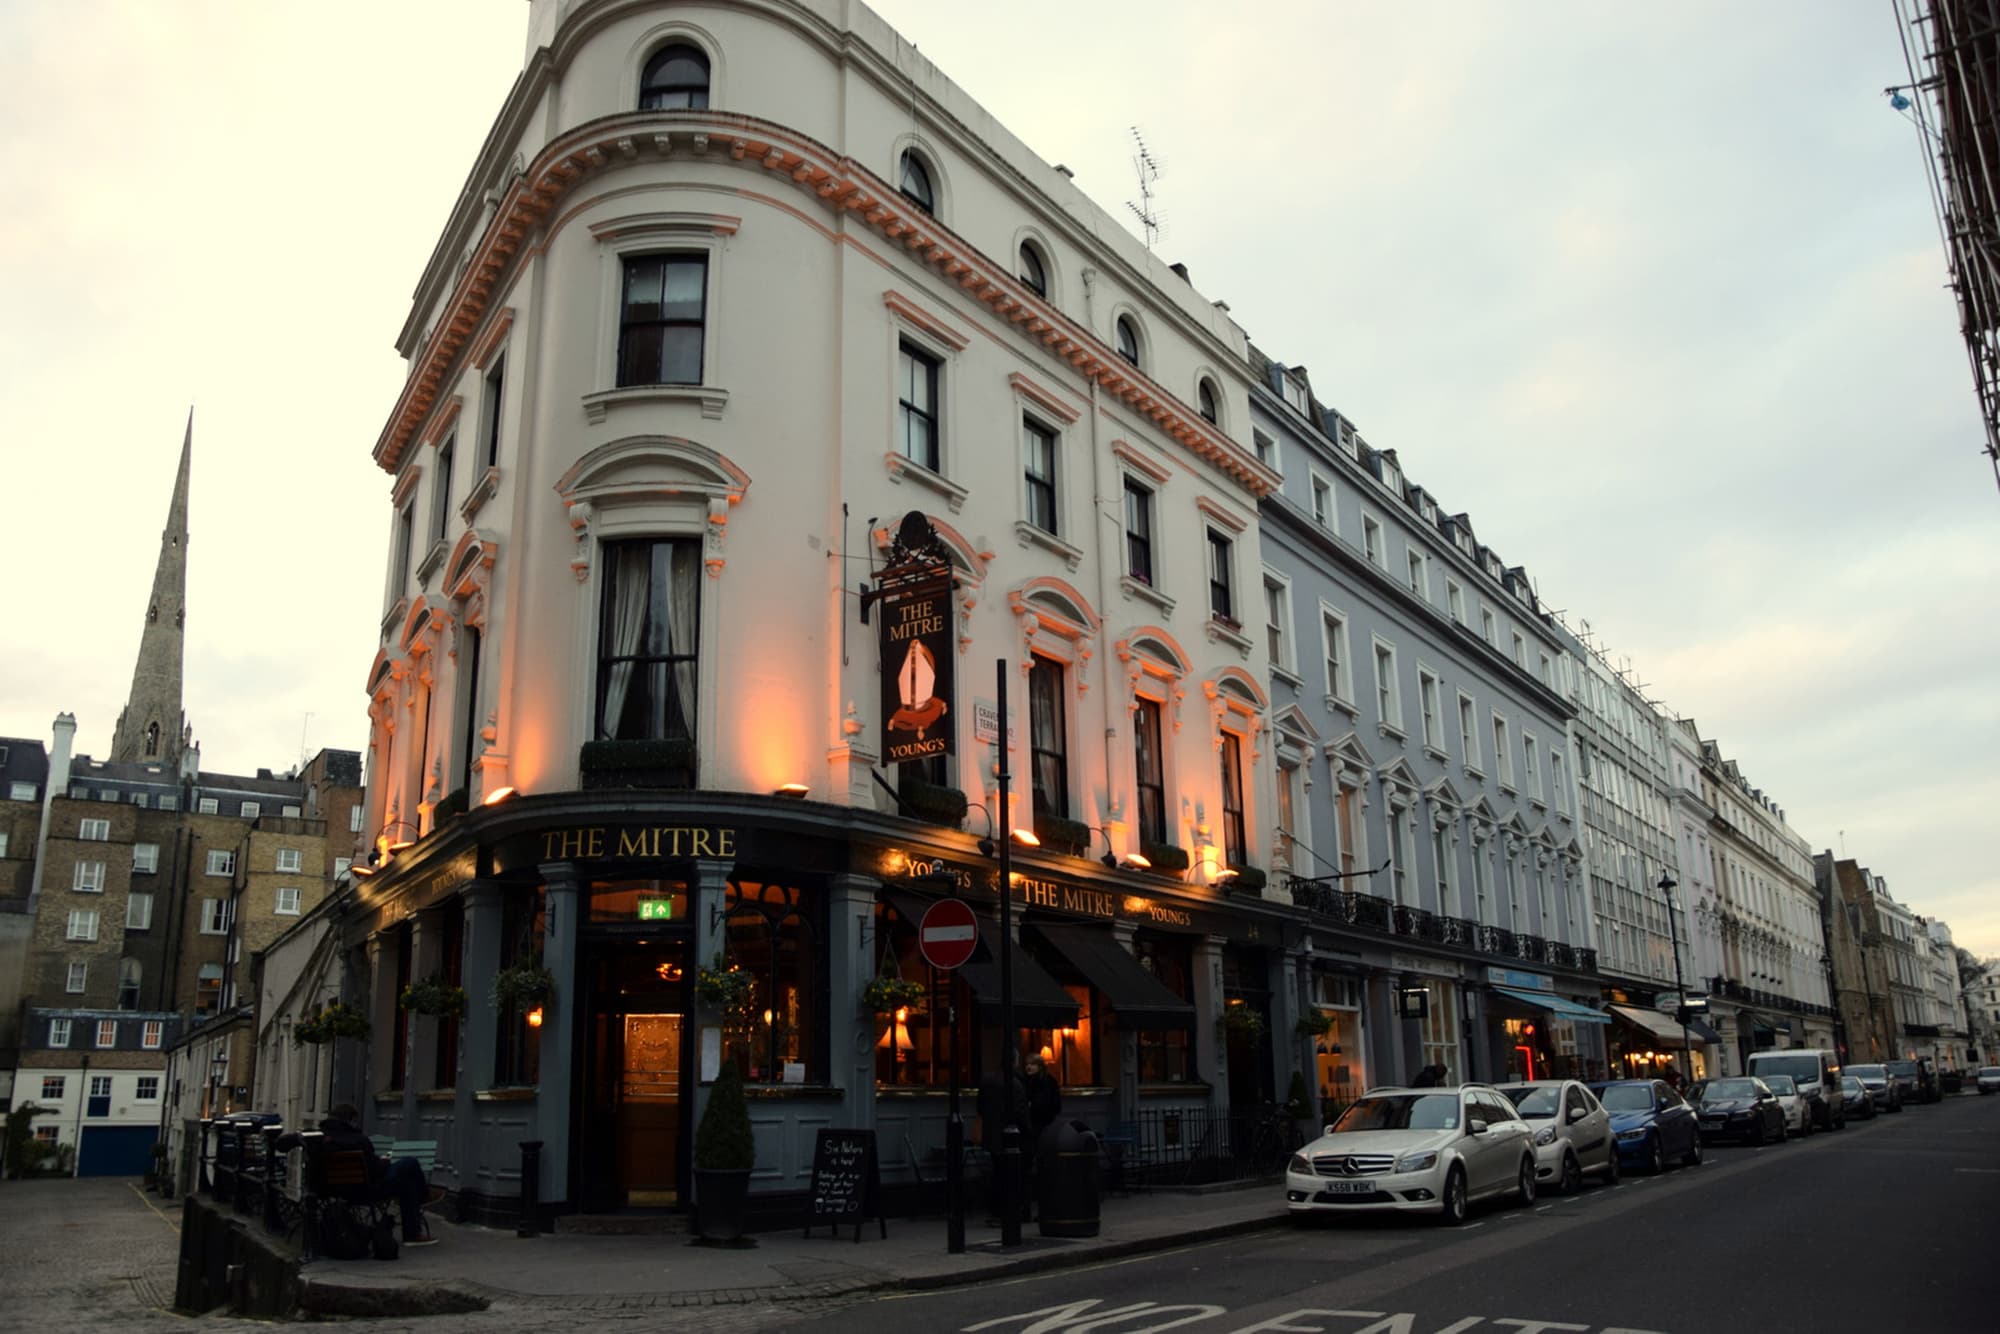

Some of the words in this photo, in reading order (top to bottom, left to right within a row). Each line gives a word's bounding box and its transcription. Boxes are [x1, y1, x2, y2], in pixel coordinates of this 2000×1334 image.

[899, 601, 933, 623] THE
[889, 616, 944, 642] MITRE
[889, 738, 945, 758] YOUNG'S
[541, 827, 607, 861] THE
[615, 827, 737, 858] MITRE
[1022, 879, 1059, 908] THE
[1063, 887, 1114, 917] MITRE
[1149, 906, 1192, 927] YOUNG'S
